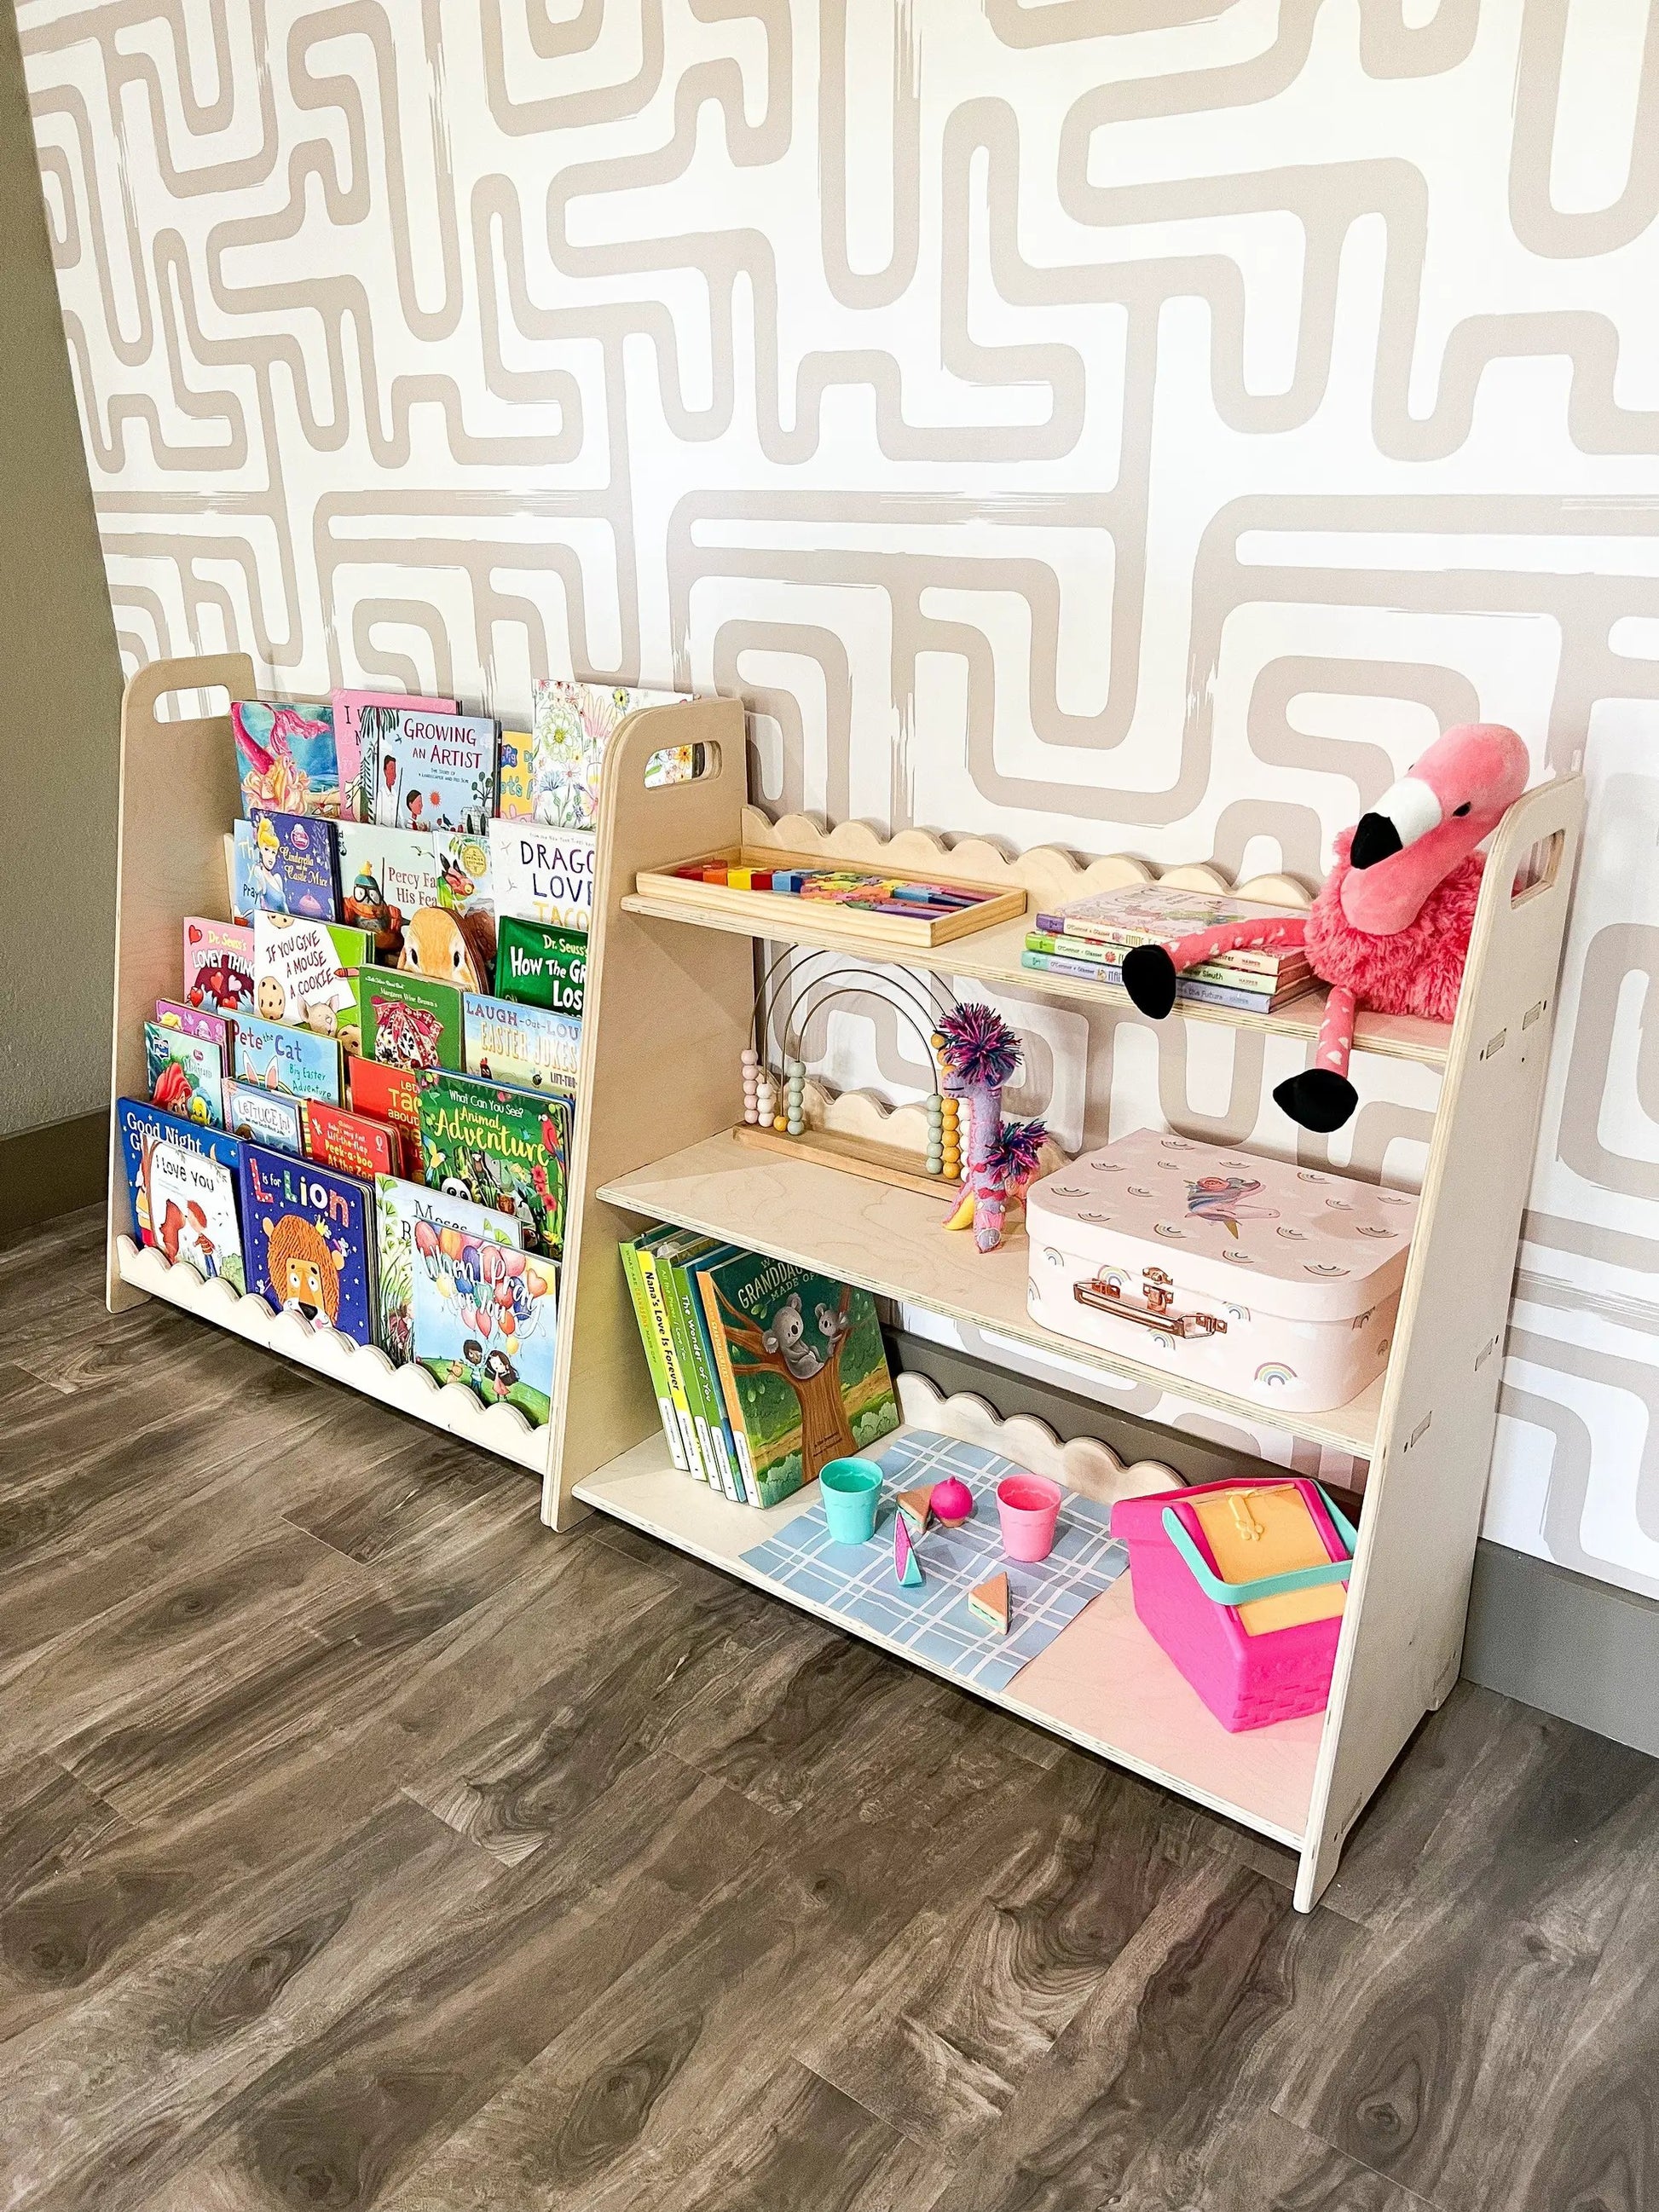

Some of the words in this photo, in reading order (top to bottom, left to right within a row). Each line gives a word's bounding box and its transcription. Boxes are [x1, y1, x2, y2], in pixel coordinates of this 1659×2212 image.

[404, 718, 477, 747] GROWING
[413, 748, 426, 759] AN
[431, 745, 483, 769] ARTIST
[279, 846, 314, 866] Cinderella
[284, 864, 308, 883] Castle
[388, 867, 420, 889] Percy
[396, 887, 415, 904] His
[207, 930, 220, 944] Dr.
[266, 944, 276, 964] IF
[278, 938, 295, 959] YOU
[296, 929, 321, 951] GIVE
[542, 933, 558, 950] Dr.
[191, 949, 223, 969] LOVEY
[286, 962, 292, 979] A
[292, 950, 327, 975] MOUSE
[290, 984, 296, 1000] A
[298, 967, 334, 996] COOKIE
[1202, 970, 1223, 980] Sleuth
[232, 1019, 263, 1050] Pete
[263, 1031, 274, 1043] the
[275, 1034, 303, 1063] Cat
[480, 1021, 529, 1062] EASTER
[534, 1036, 579, 1074] JOKES
[289, 1063, 301, 1080] Big
[303, 1066, 327, 1081] Easter
[292, 1080, 332, 1100] Adventure
[448, 1089, 469, 1105] What
[470, 1094, 488, 1110] Can
[488, 1099, 505, 1114] You
[506, 1105, 524, 1118] See?
[126, 1112, 162, 1141] Good
[460, 1106, 500, 1131] Animal
[433, 1107, 550, 1167] Adventure
[155, 1154, 160, 1169] I
[325, 1138, 373, 1169] Peek-a-boo
[327, 1153, 338, 1168] At
[338, 1158, 354, 1174] the
[249, 1158, 275, 1204] L
[262, 1172, 269, 1185] is
[269, 1173, 282, 1187] for
[283, 1170, 350, 1228] Lion
[419, 1244, 477, 1285] When
[477, 1247, 488, 1287] I
[645, 1271, 660, 1307] Nana's
[663, 1281, 672, 1294] the
[770, 1277, 800, 1302] MADE
[448, 1289, 475, 1312] for
[479, 1291, 506, 1320] You
[681, 1295, 691, 1316] The
[654, 1309, 666, 1336] Love
[661, 1337, 670, 1348] Is
[687, 1319, 703, 1363] Wonder
[664, 1349, 679, 1391] Forever
[698, 1366, 708, 1382] of
[702, 1383, 712, 1402] You
